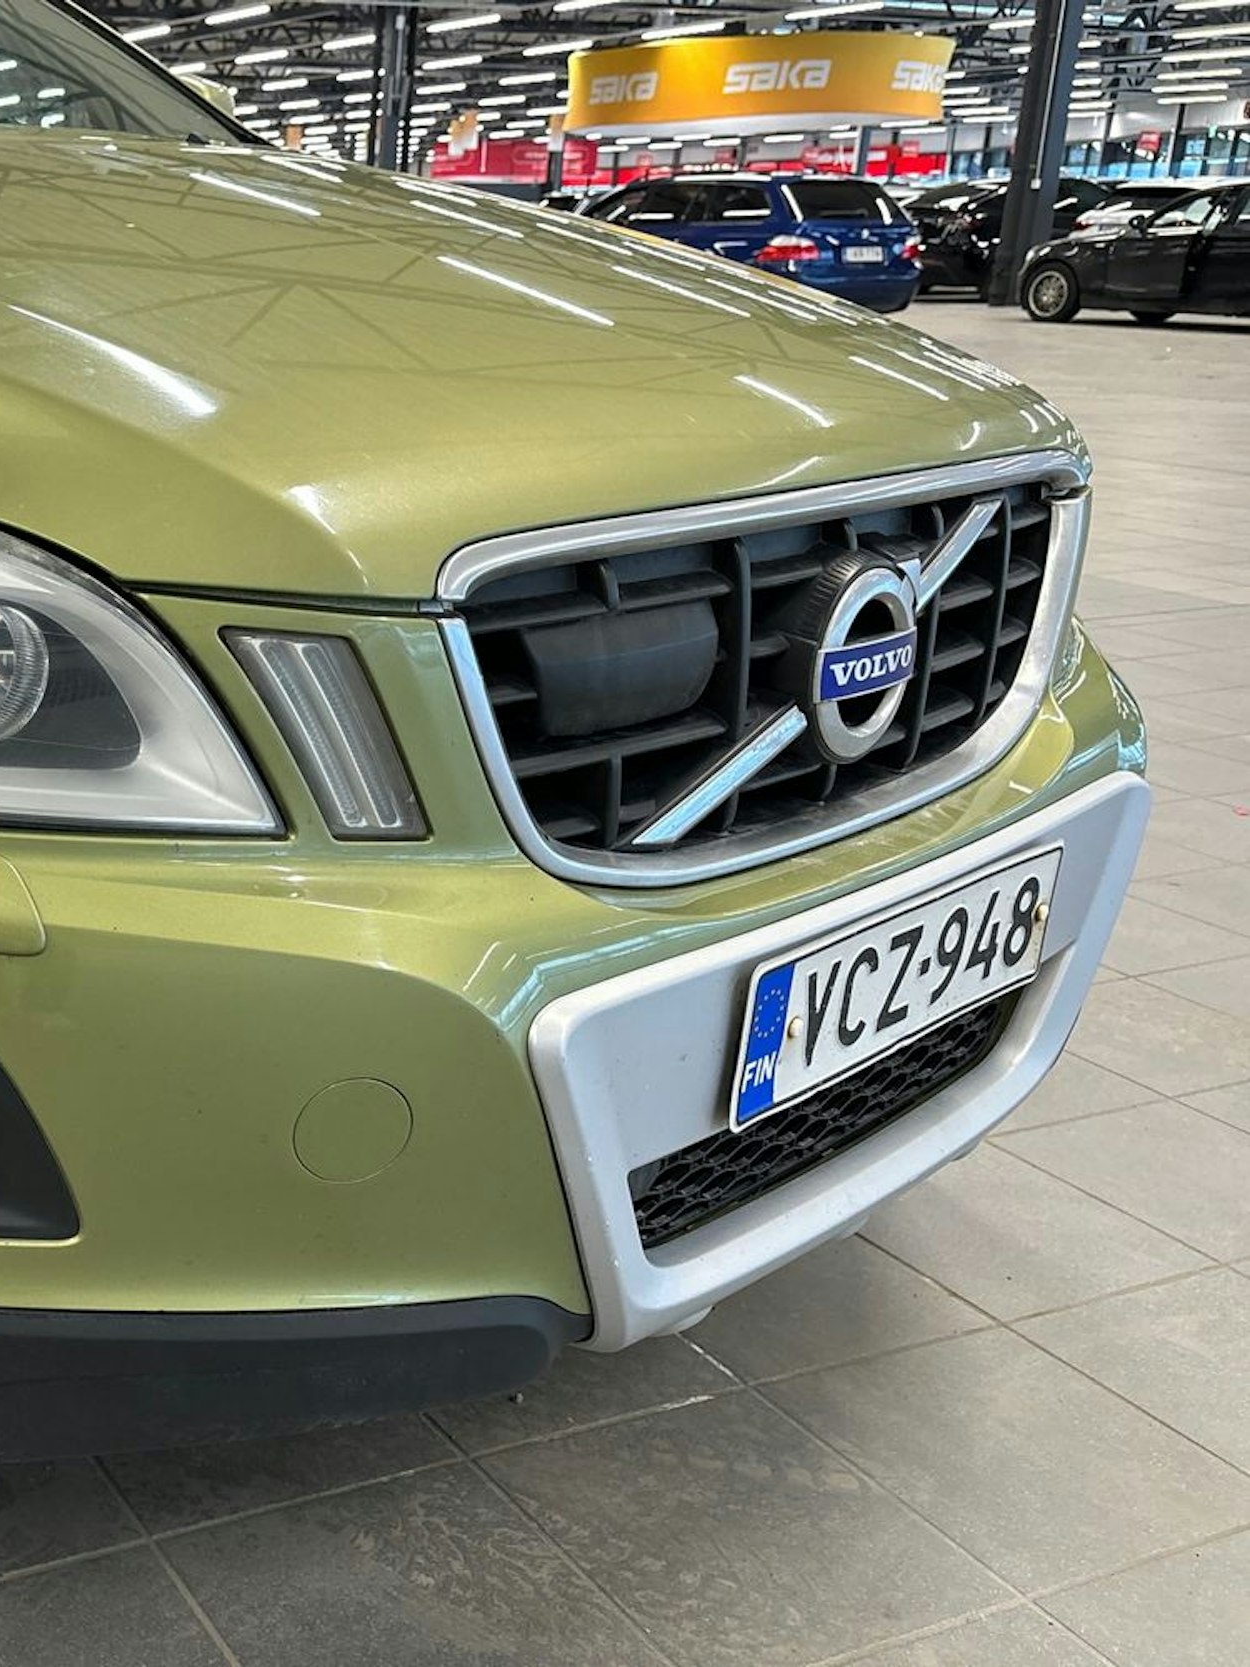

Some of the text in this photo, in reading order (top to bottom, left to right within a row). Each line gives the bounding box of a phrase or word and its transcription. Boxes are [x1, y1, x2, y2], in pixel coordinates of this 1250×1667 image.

[830, 645, 913, 686] VOLVO
[805, 876, 1040, 1067] VCZ-948
[741, 1052, 777, 1093] FIN
